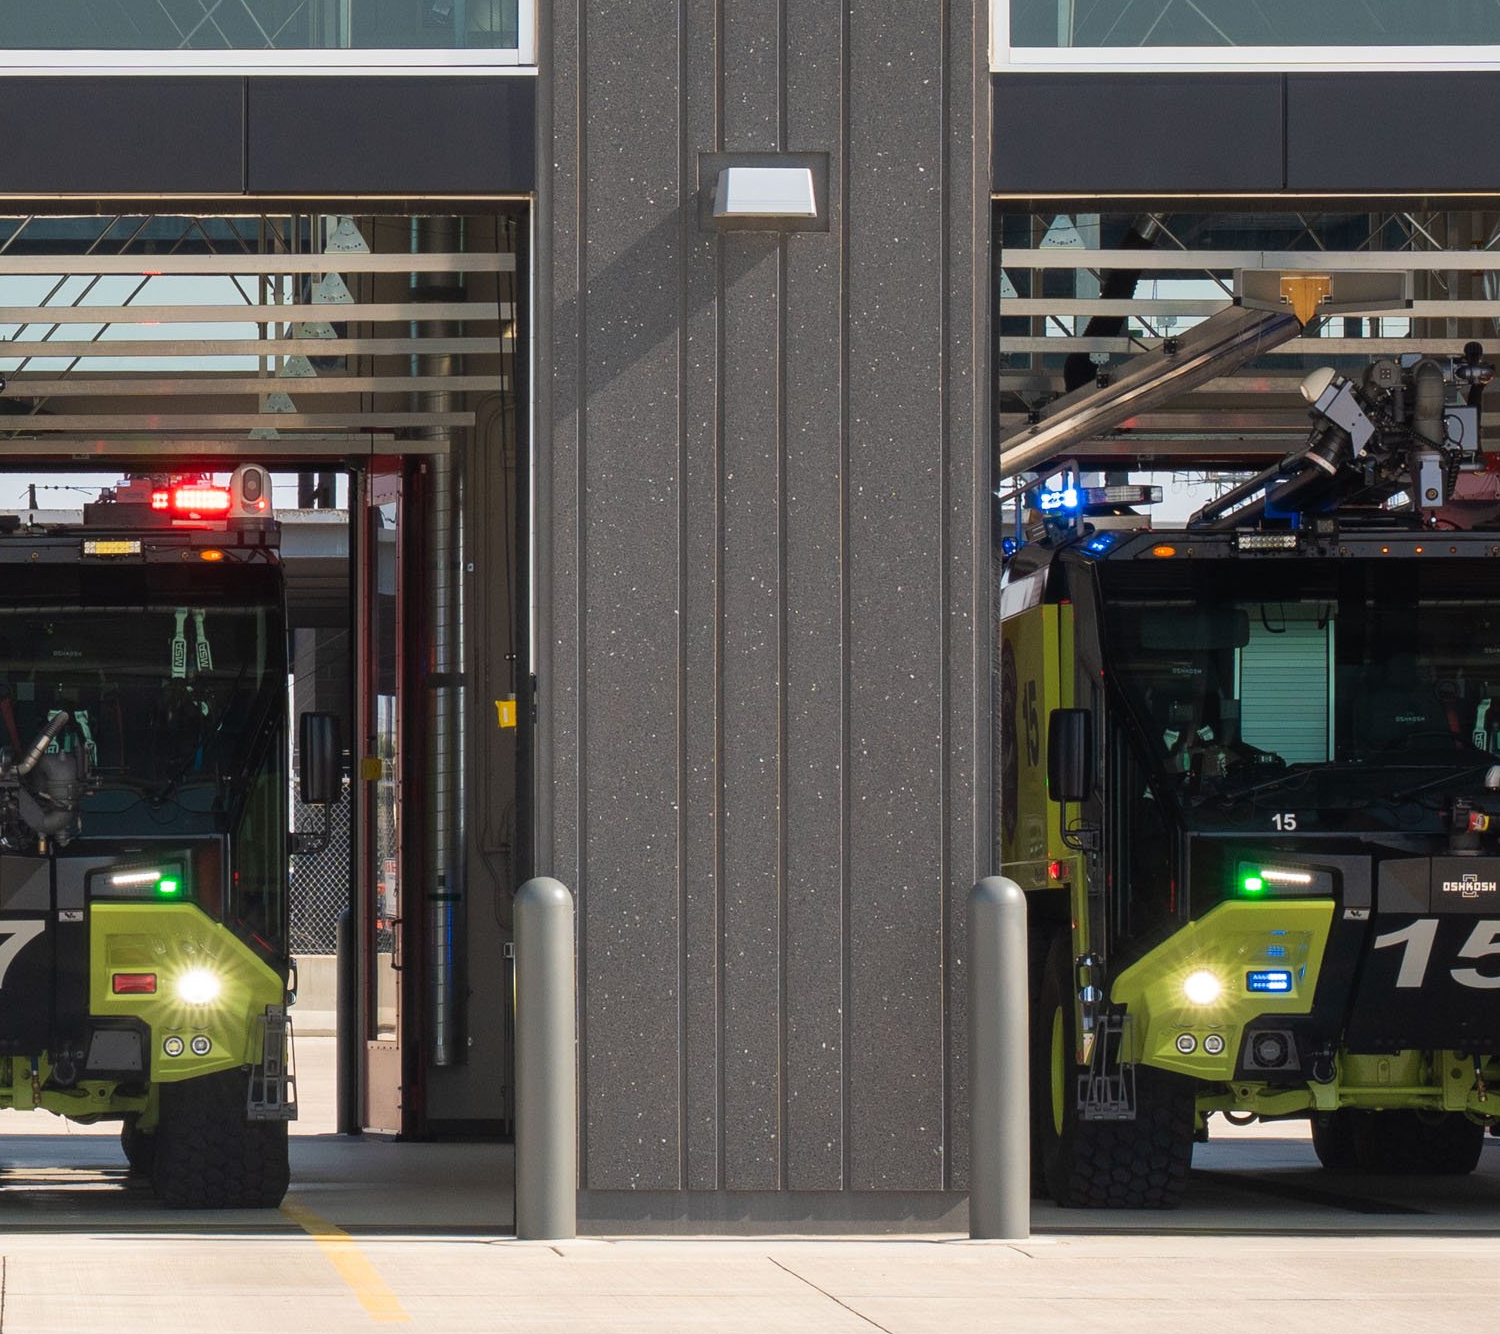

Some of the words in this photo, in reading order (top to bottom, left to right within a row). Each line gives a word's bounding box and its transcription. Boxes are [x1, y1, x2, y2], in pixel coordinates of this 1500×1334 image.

[175, 642, 184, 667] MSA
[198, 643, 208, 667] MSA
[1022, 680, 1039, 767] 15
[1271, 813, 1297, 831] 15
[1442, 881, 1497, 892] OSHKOSH
